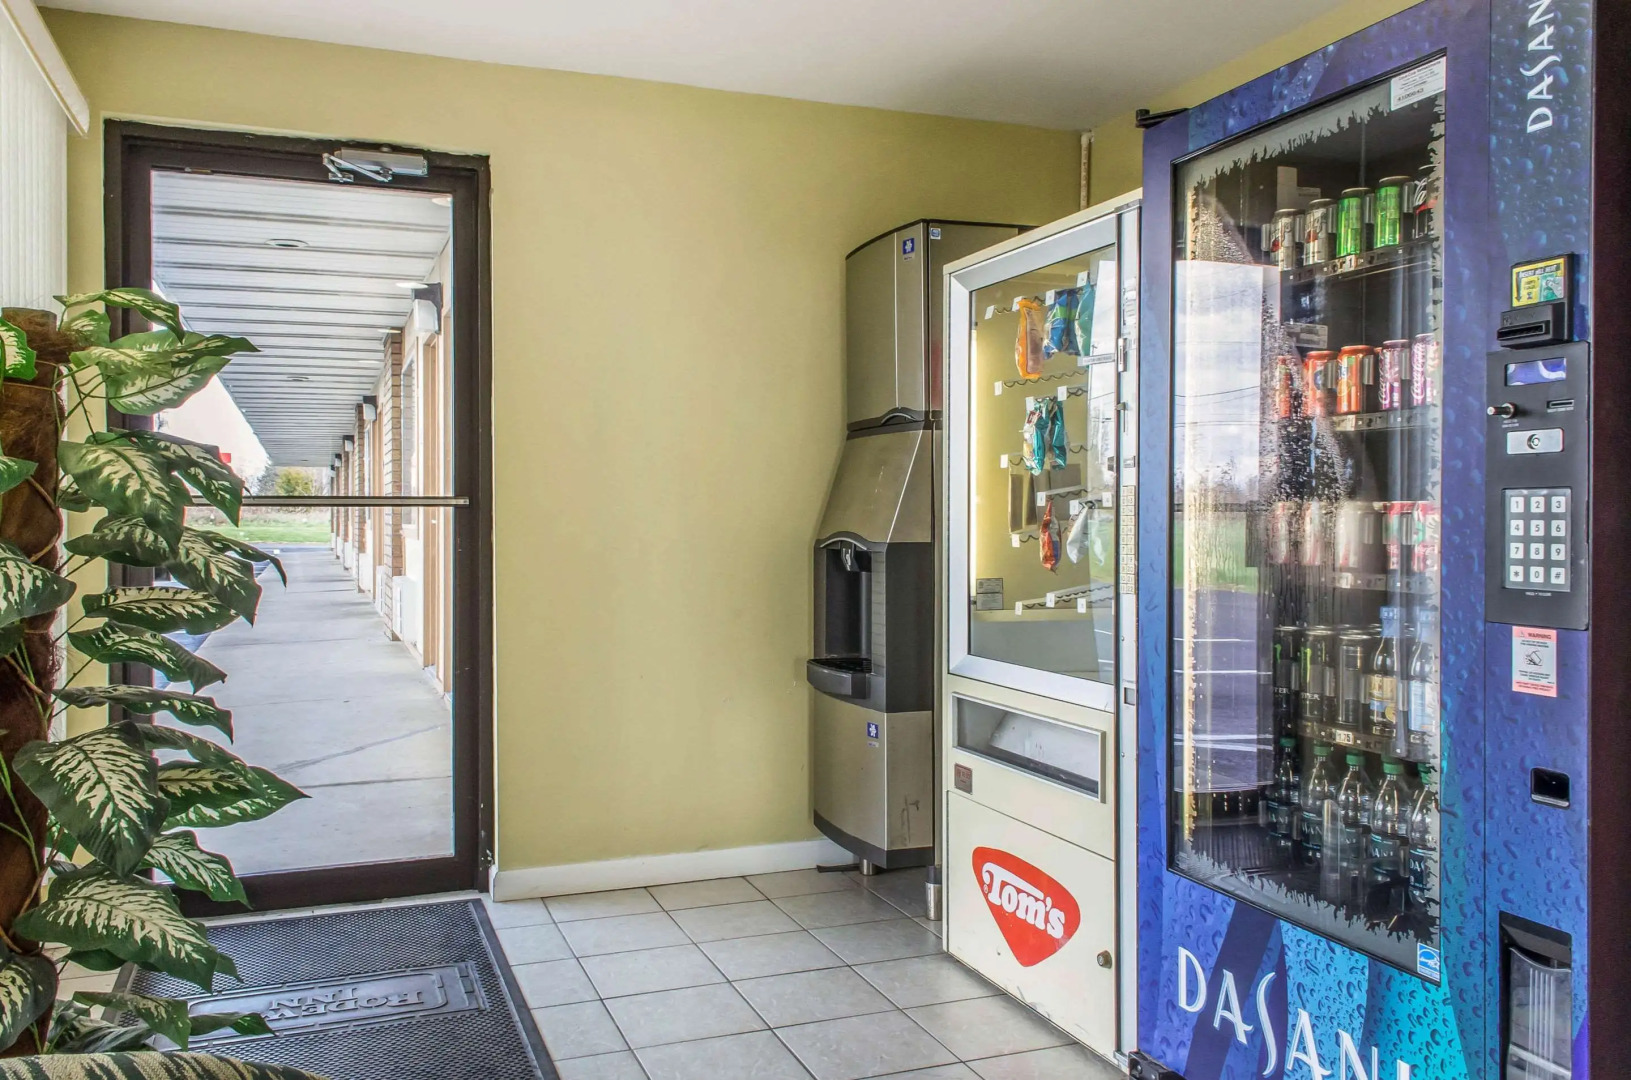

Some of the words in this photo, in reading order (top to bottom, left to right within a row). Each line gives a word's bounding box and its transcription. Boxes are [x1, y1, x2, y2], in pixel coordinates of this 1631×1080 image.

[1535, 501, 1540, 509] 2
[1556, 501, 1561, 509] 3
[1514, 524, 1520, 532] 4
[1535, 524, 1540, 532] 5
[1555, 548, 1561, 556] 9
[1534, 571, 1540, 579] 0
[1527, 632, 1552, 640] WARNING
[1338, 733, 1351, 743] 1.75
[982, 862, 1066, 939] Tom's
[269, 987, 358, 1011] INN
[1178, 946, 1411, 1080] DASAN
